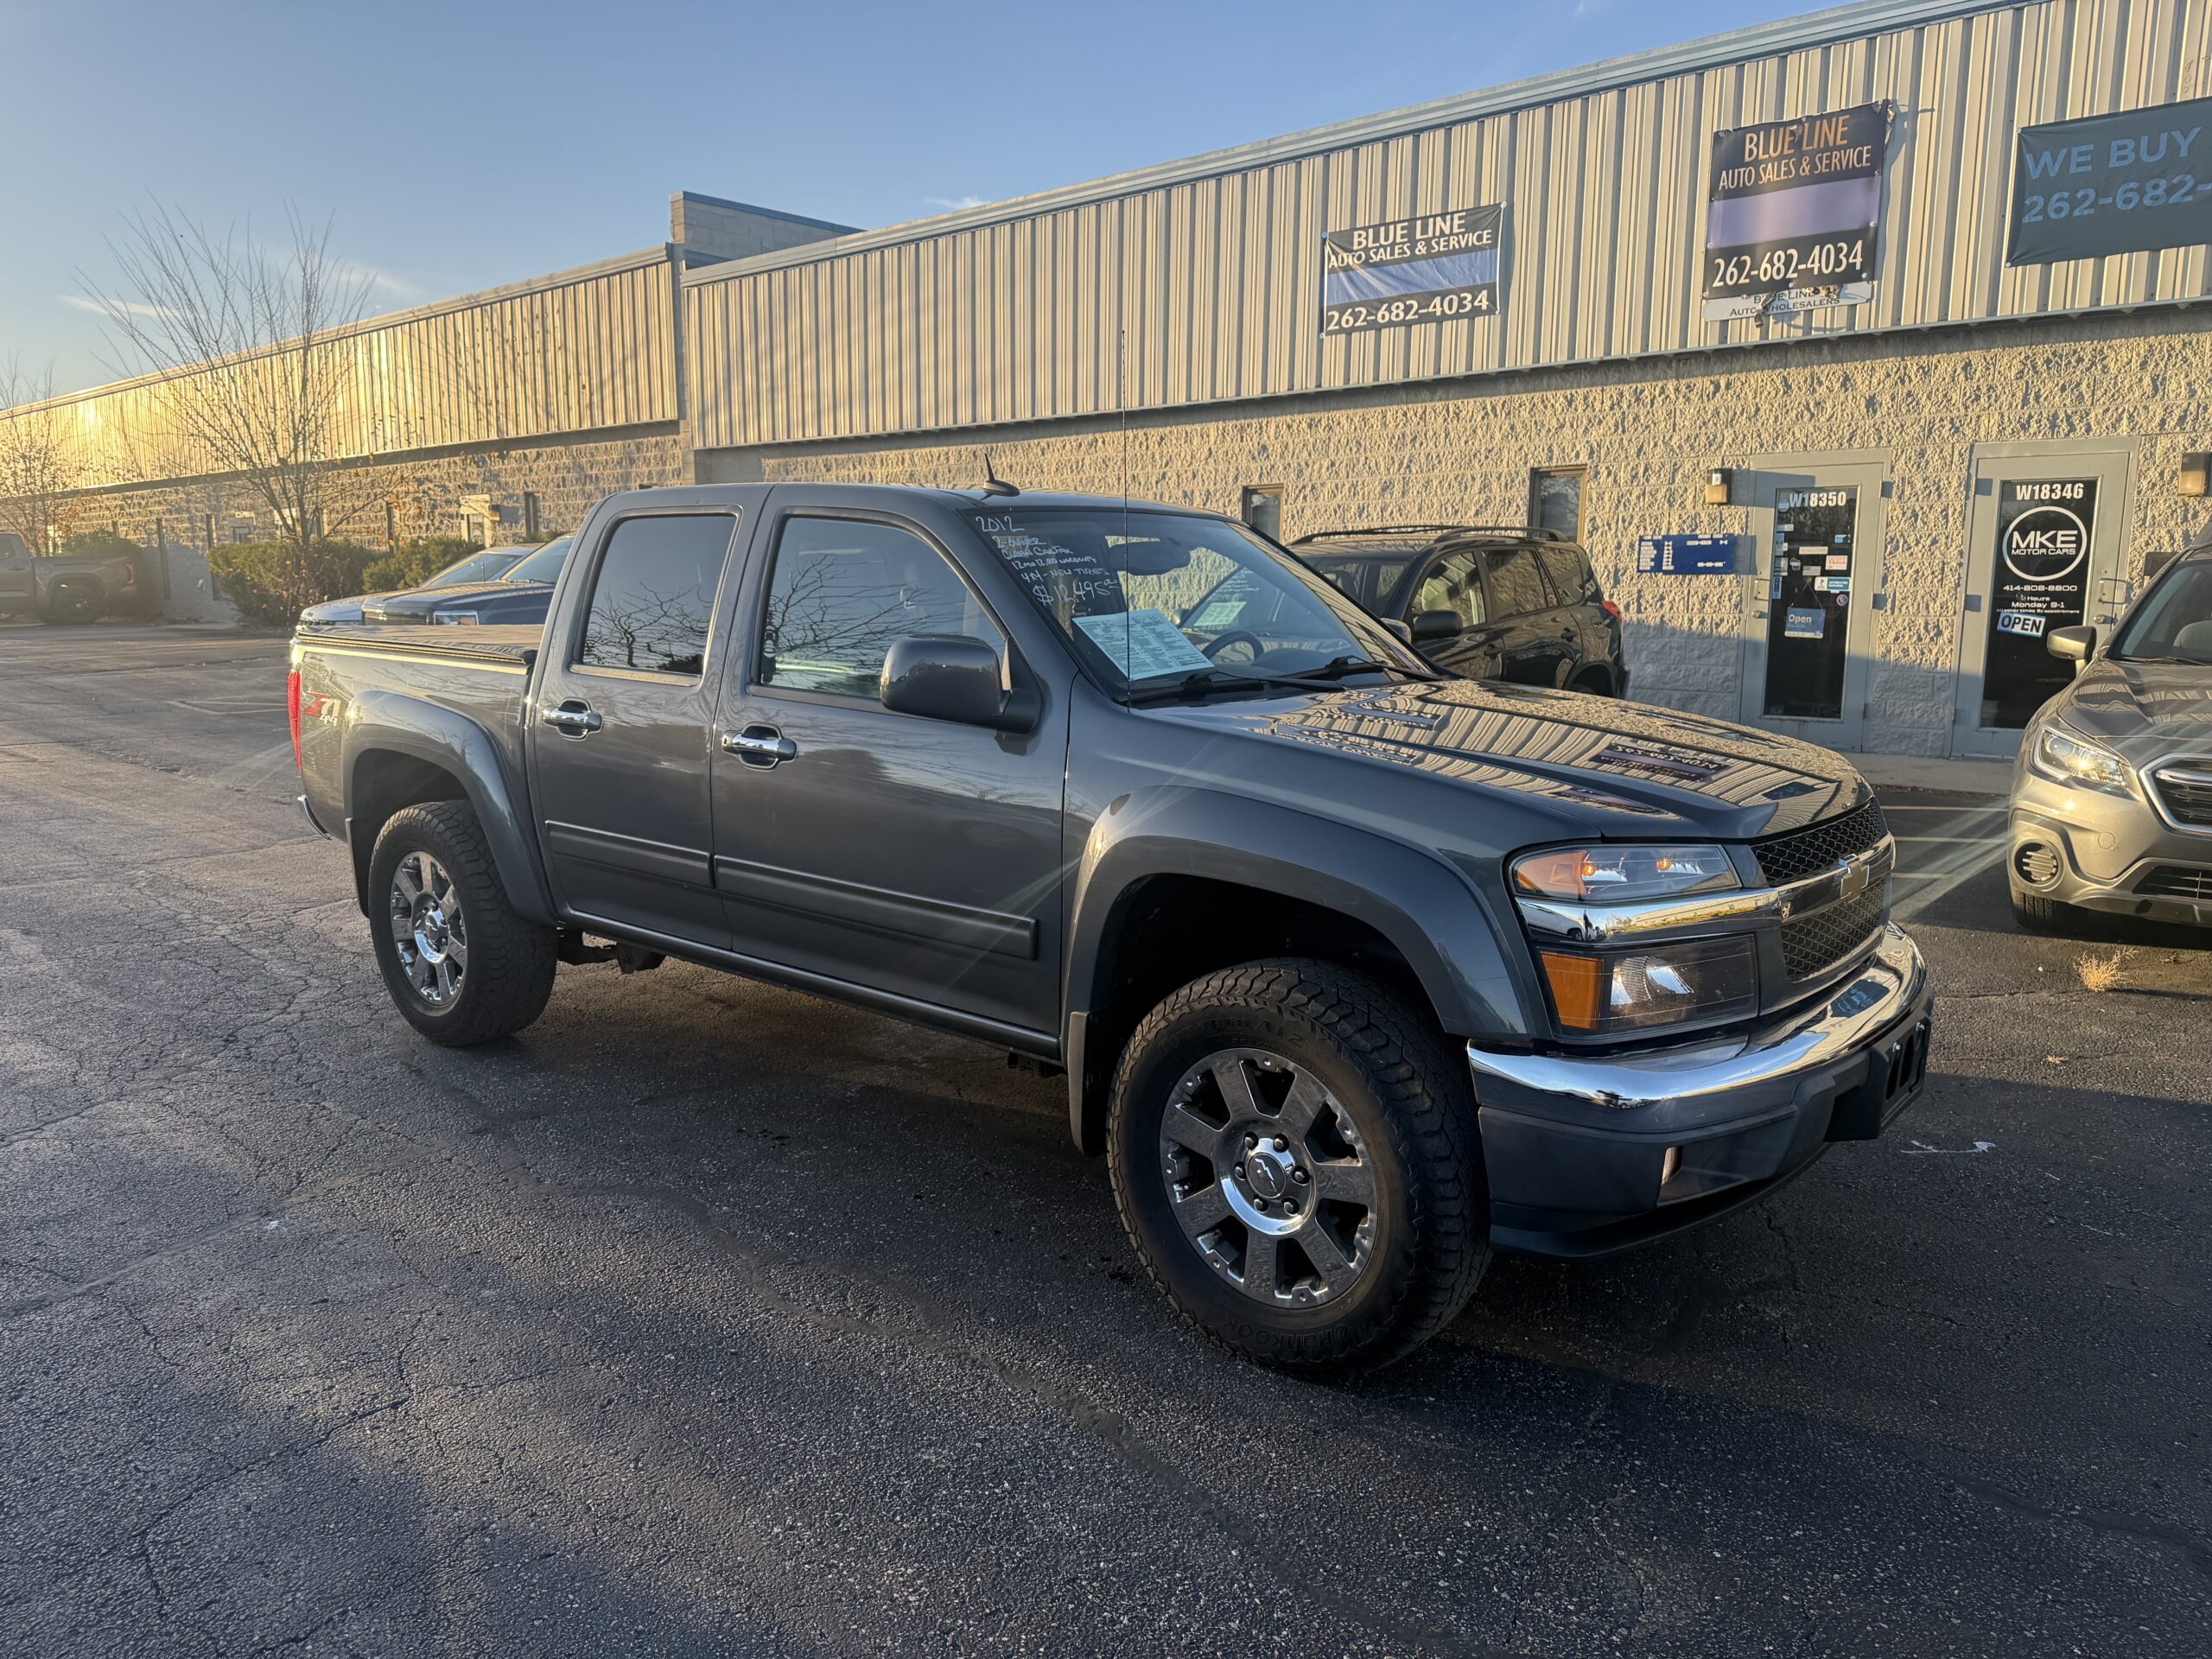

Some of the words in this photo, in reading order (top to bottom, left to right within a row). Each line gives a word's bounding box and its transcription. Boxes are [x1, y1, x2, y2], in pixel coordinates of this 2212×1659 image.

[1744, 125, 1795, 162] BLUE
[1802, 114, 1850, 150] LINE
[2025, 144, 2094, 180] WE
[2109, 127, 2202, 168] BUY
[1719, 166, 1756, 190] AUTO
[1758, 158, 1796, 184] SALES
[1799, 156, 1811, 176] &
[1814, 145, 1872, 174] SERVICE
[1352, 222, 1408, 251] BLUE
[1415, 212, 1466, 239] LINE
[1328, 251, 1365, 269] AUTO
[1369, 243, 1411, 263] SALES
[1415, 241, 1427, 255] &
[1431, 229, 1492, 252] SERVICE
[1712, 240, 1863, 288] 262-682-4034
[1326, 289, 1489, 331] 262-682-4034
[1754, 291, 1785, 304] BE
[1789, 491, 1847, 507] W18350
[2016, 483, 2084, 500] W18346
[976, 516, 1025, 532] 2012
[2012, 530, 2078, 549] MKE
[1788, 613, 1812, 625] Open
[2001, 614, 2042, 633] OPEN
[304, 691, 341, 718] Z71
